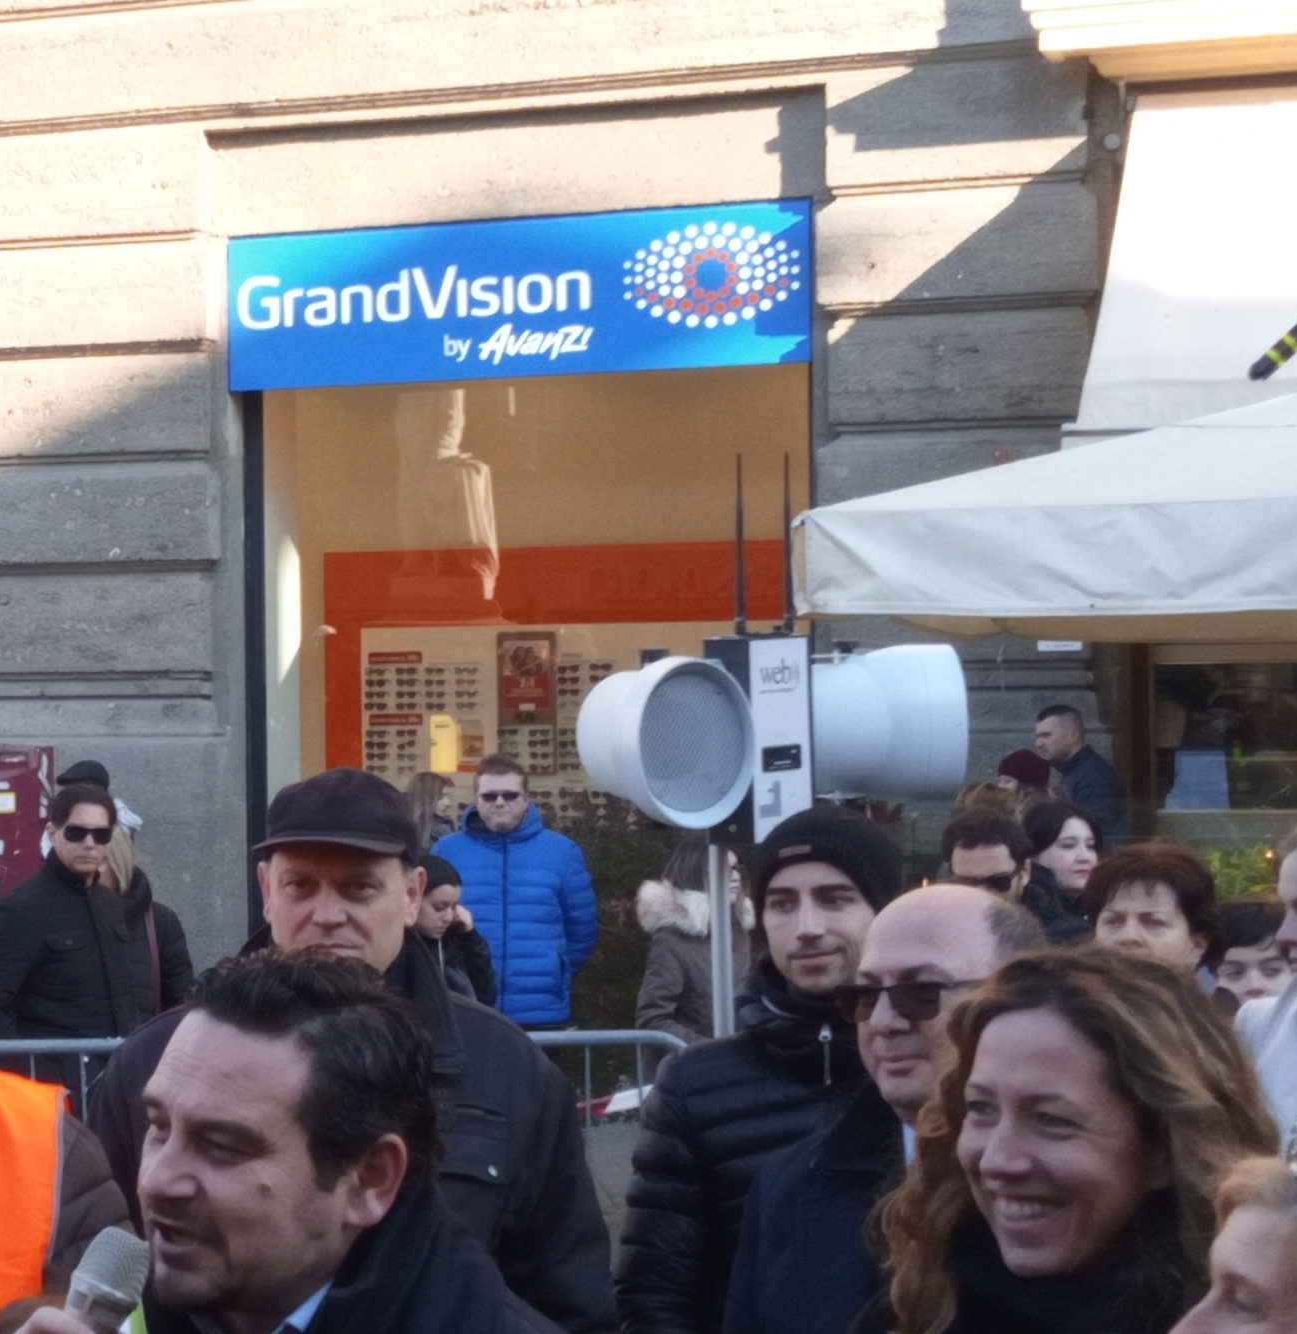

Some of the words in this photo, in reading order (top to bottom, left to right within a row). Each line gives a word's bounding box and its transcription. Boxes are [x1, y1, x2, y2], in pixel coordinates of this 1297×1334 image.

[236, 264, 592, 330] GrandVision
[443, 334, 471, 362] by
[479, 324, 594, 365] Avanzi
